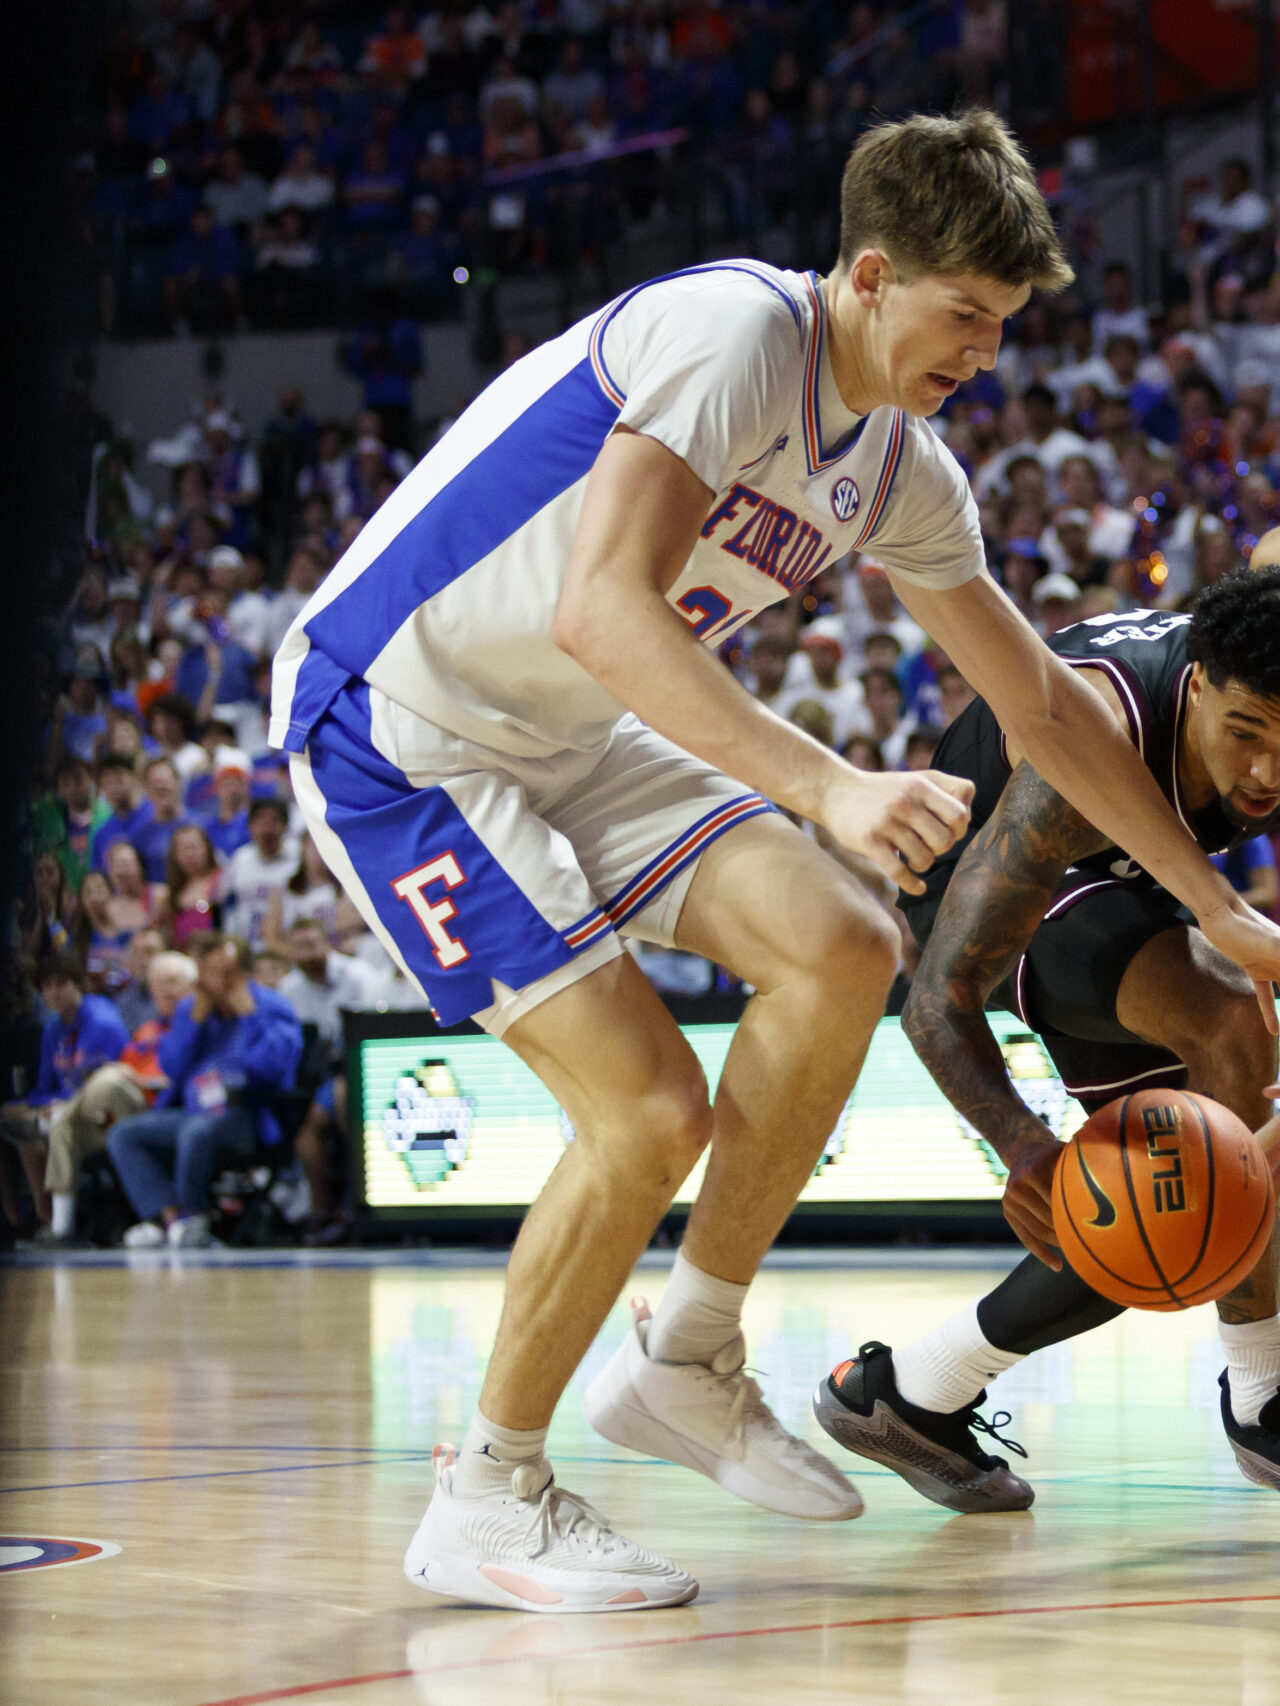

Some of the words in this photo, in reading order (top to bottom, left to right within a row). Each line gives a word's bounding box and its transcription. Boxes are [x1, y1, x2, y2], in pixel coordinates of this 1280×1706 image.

[833, 479, 859, 520] SEC
[389, 849, 471, 971] F
[1142, 1105, 1187, 1215] ELITE
